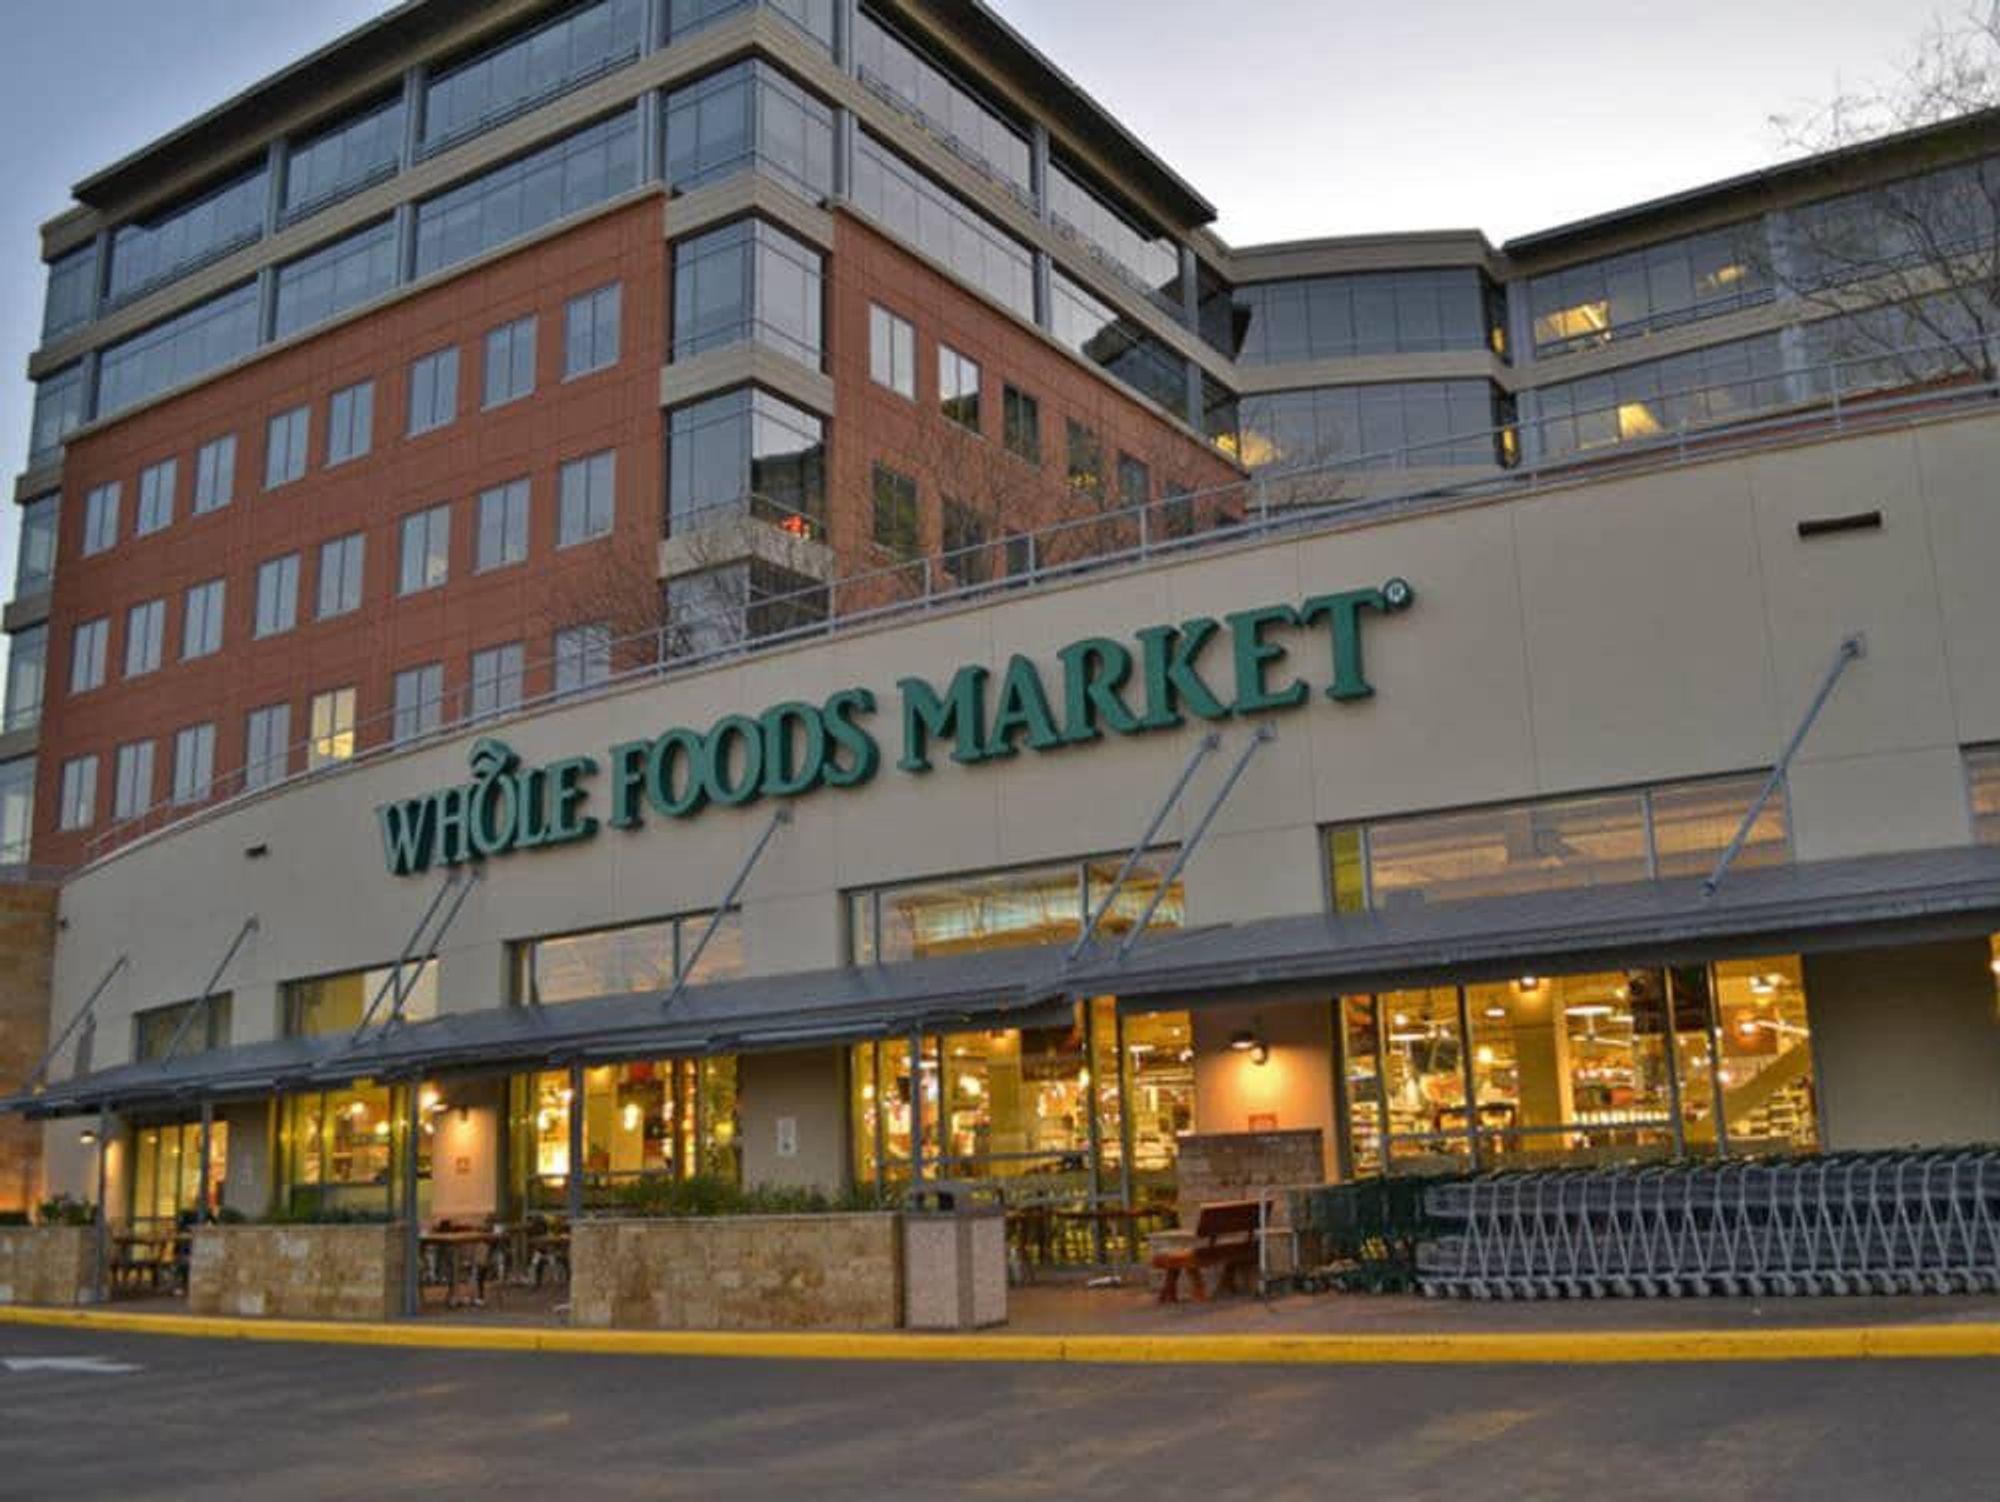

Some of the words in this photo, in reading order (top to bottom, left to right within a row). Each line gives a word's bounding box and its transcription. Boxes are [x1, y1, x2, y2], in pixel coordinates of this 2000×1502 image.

[376, 738, 598, 875] WHOLE
[607, 688, 880, 830] FOODS
[896, 587, 1386, 772] MARKET
